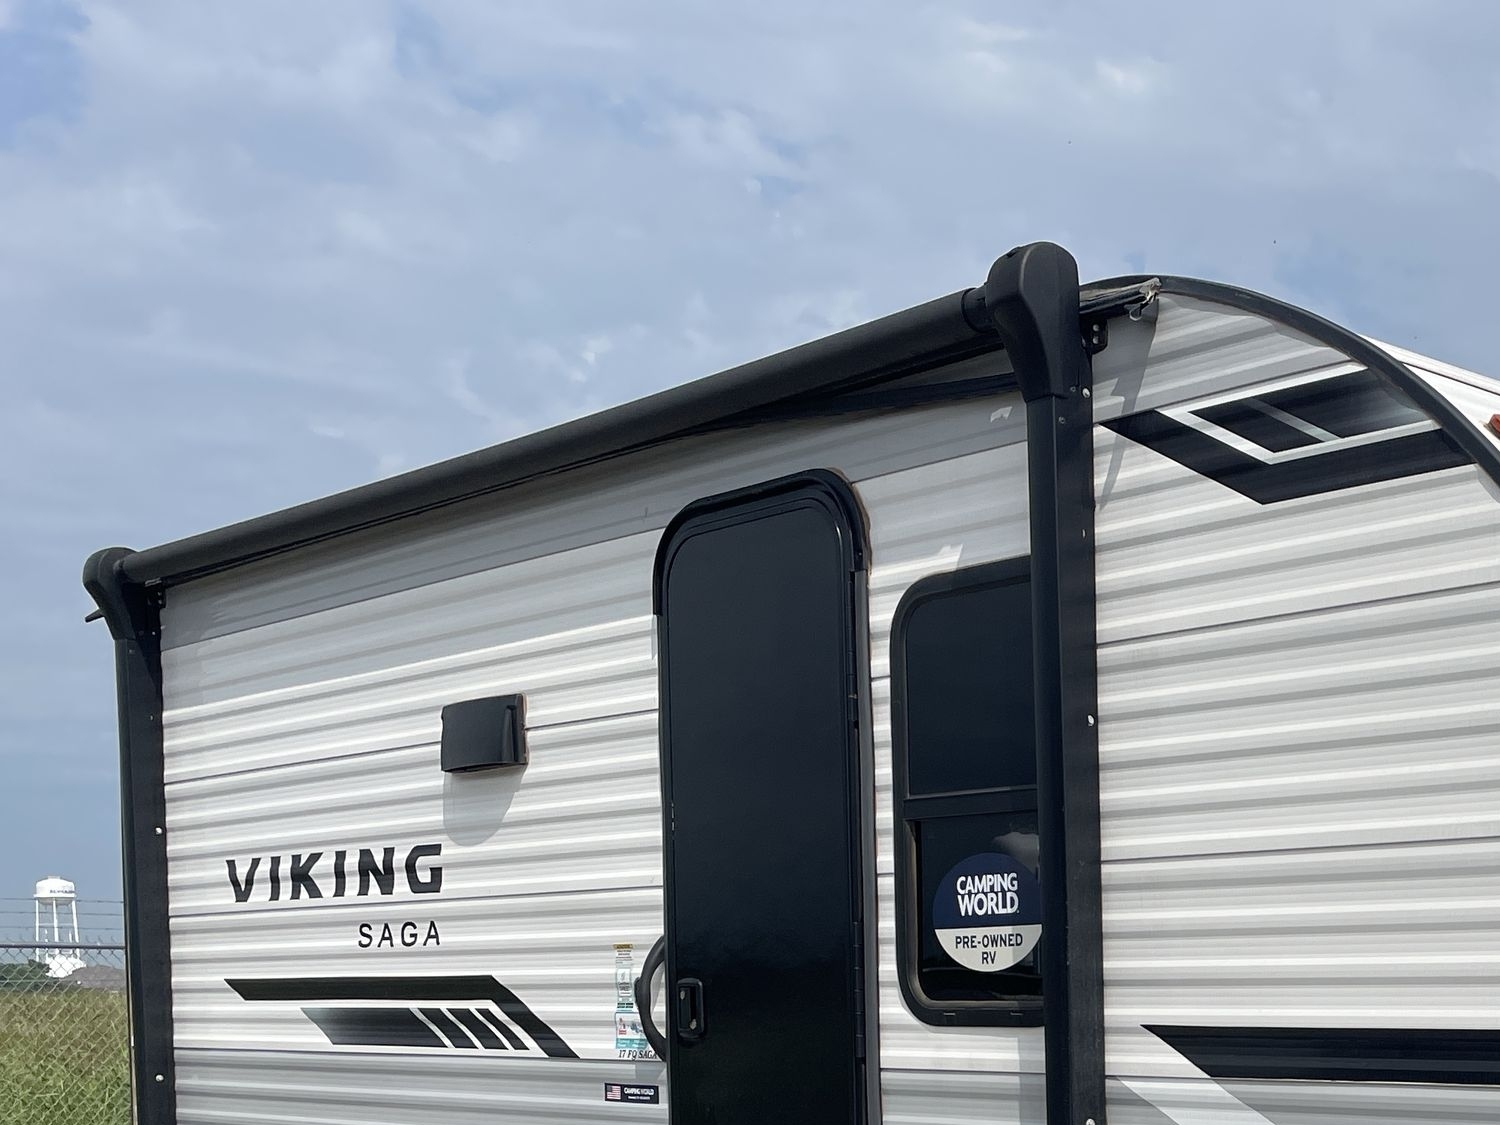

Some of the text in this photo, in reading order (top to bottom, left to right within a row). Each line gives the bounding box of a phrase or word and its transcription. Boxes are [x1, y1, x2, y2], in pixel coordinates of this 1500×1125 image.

[225, 843, 443, 903] VIKING
[956, 872, 1018, 895] CAMPING
[358, 920, 441, 949] SAGA
[955, 933, 1024, 949] PRE-OWNED
[981, 950, 997, 965] RV
